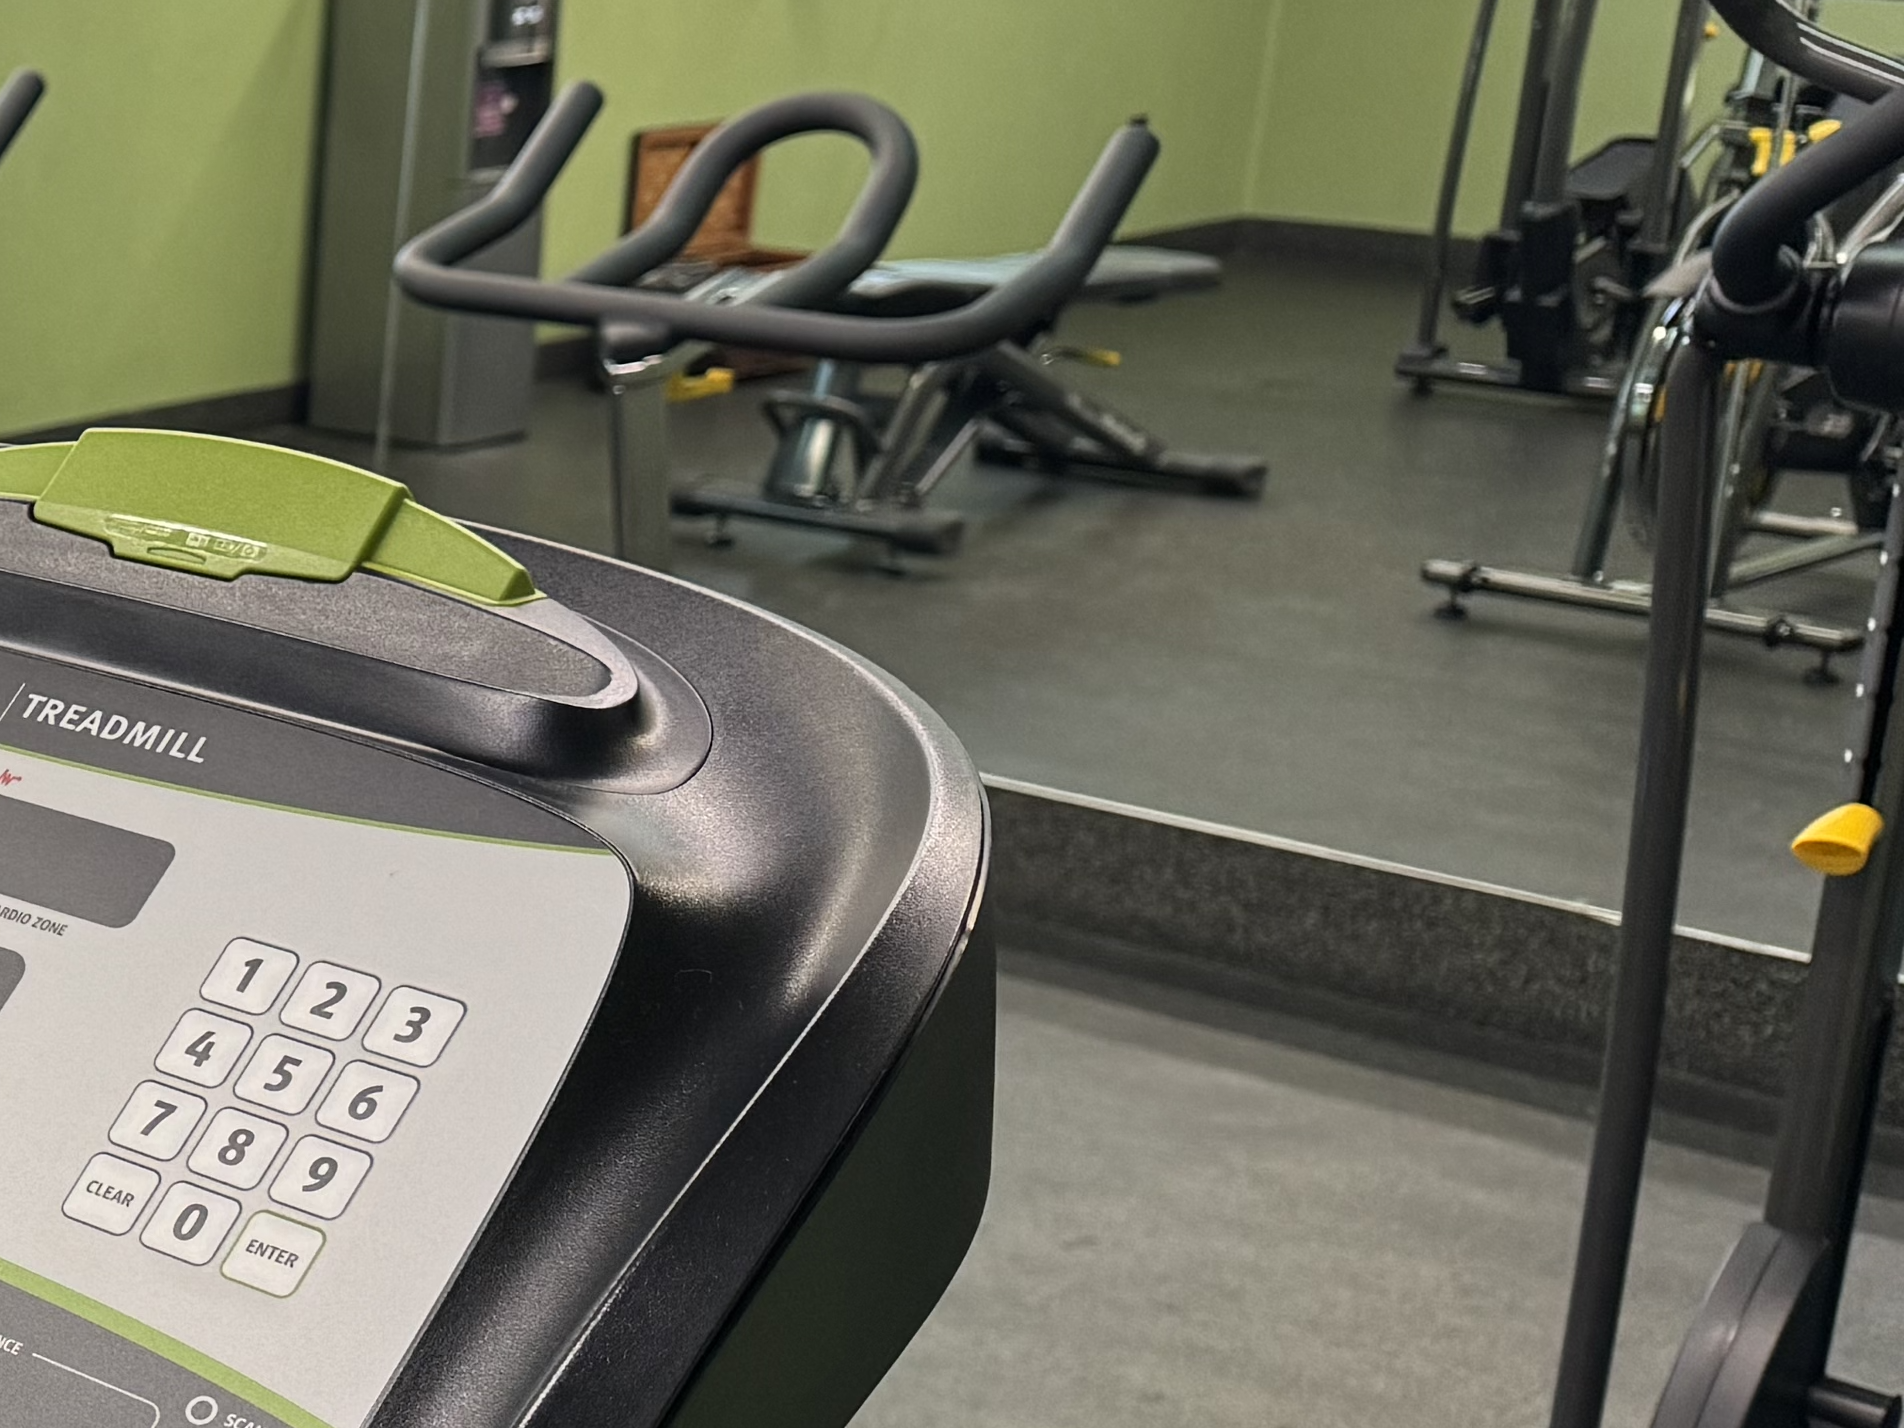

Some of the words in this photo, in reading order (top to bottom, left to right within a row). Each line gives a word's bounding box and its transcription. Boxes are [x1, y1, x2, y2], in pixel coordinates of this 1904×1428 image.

[22, 693, 206, 763] TREADMILL
[30, 916, 68, 936] ZONE
[235, 958, 264, 993] 1
[309, 981, 347, 1020] 2
[392, 1006, 431, 1043] 3
[184, 1030, 216, 1067] 4
[262, 1054, 303, 1092] 5
[347, 1084, 383, 1120] 6
[139, 1099, 178, 1136] 7
[217, 1128, 255, 1166] 8
[301, 1156, 338, 1192] 9
[85, 1180, 134, 1208] CLEAR
[172, 1203, 208, 1241] 0
[245, 1239, 299, 1268] ENTER
